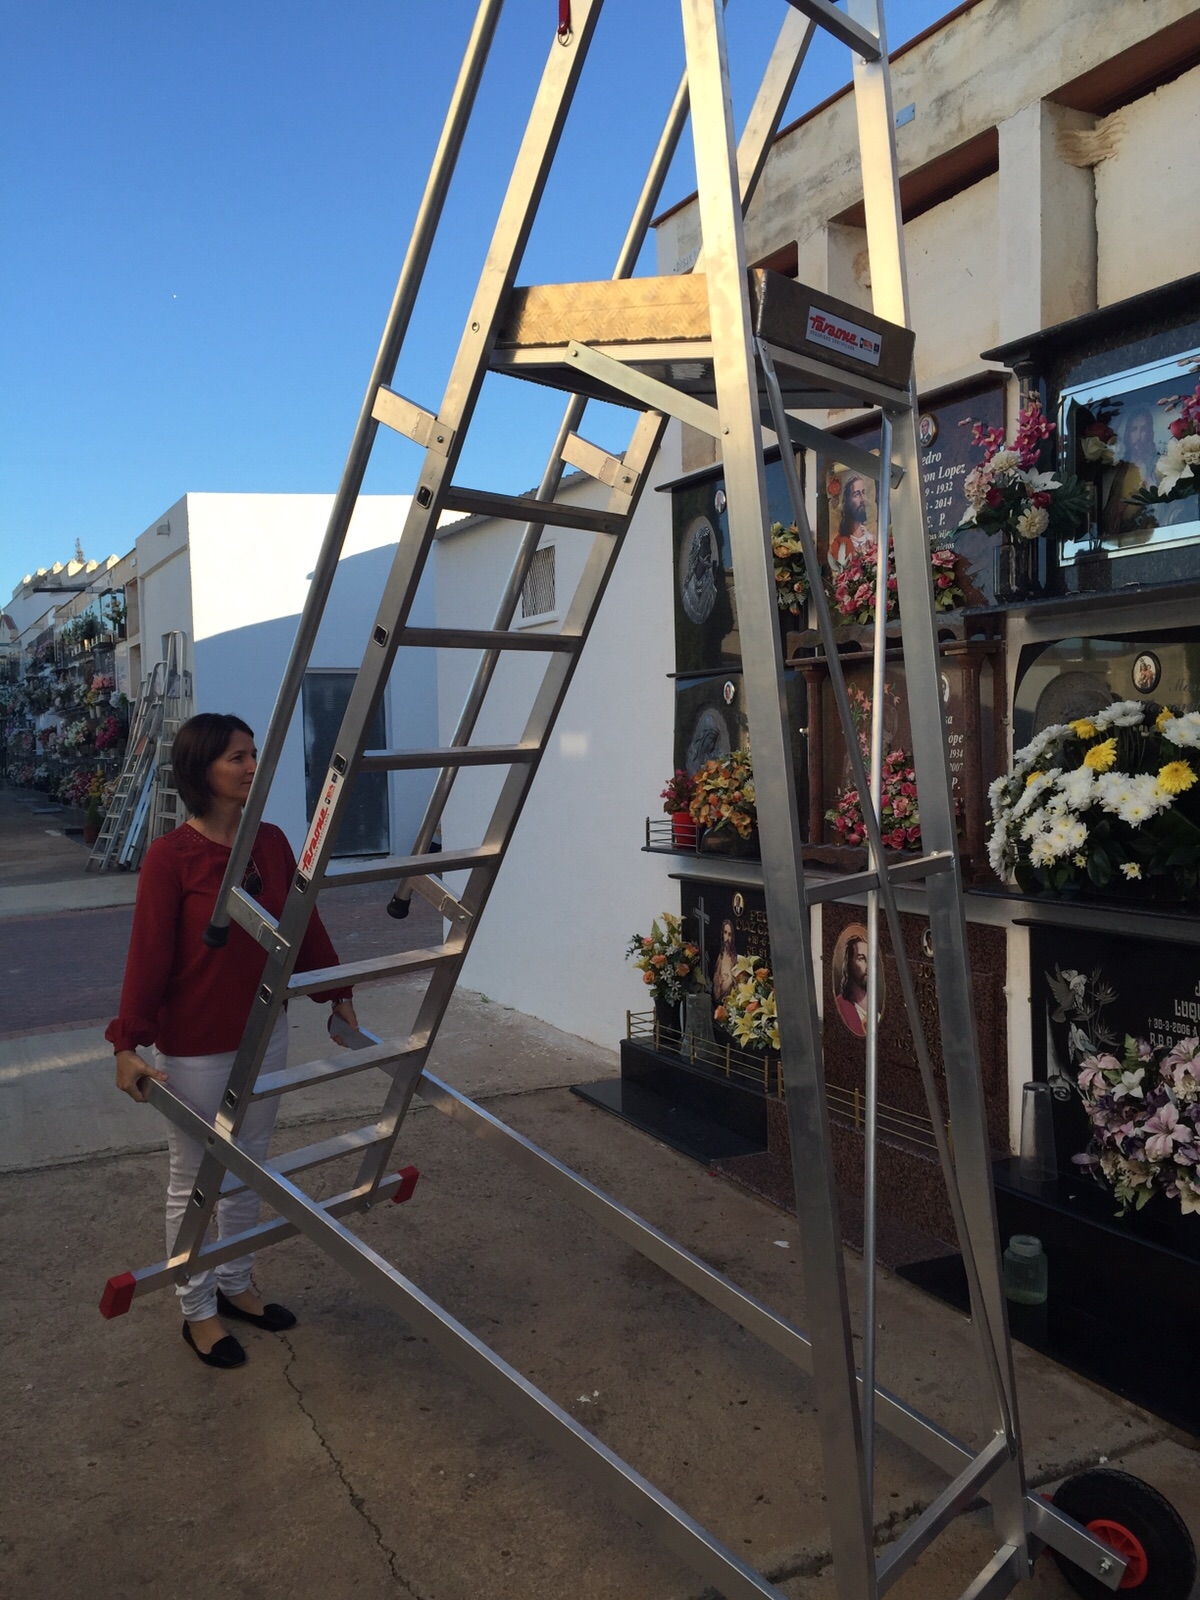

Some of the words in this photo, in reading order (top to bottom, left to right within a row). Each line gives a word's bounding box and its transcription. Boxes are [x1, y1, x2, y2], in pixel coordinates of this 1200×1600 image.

[922, 450, 942, 466] edro
[938, 463, 966, 479] Lopez
[936, 481, 953, 494] 1932
[934, 496, 952, 509] 2014
